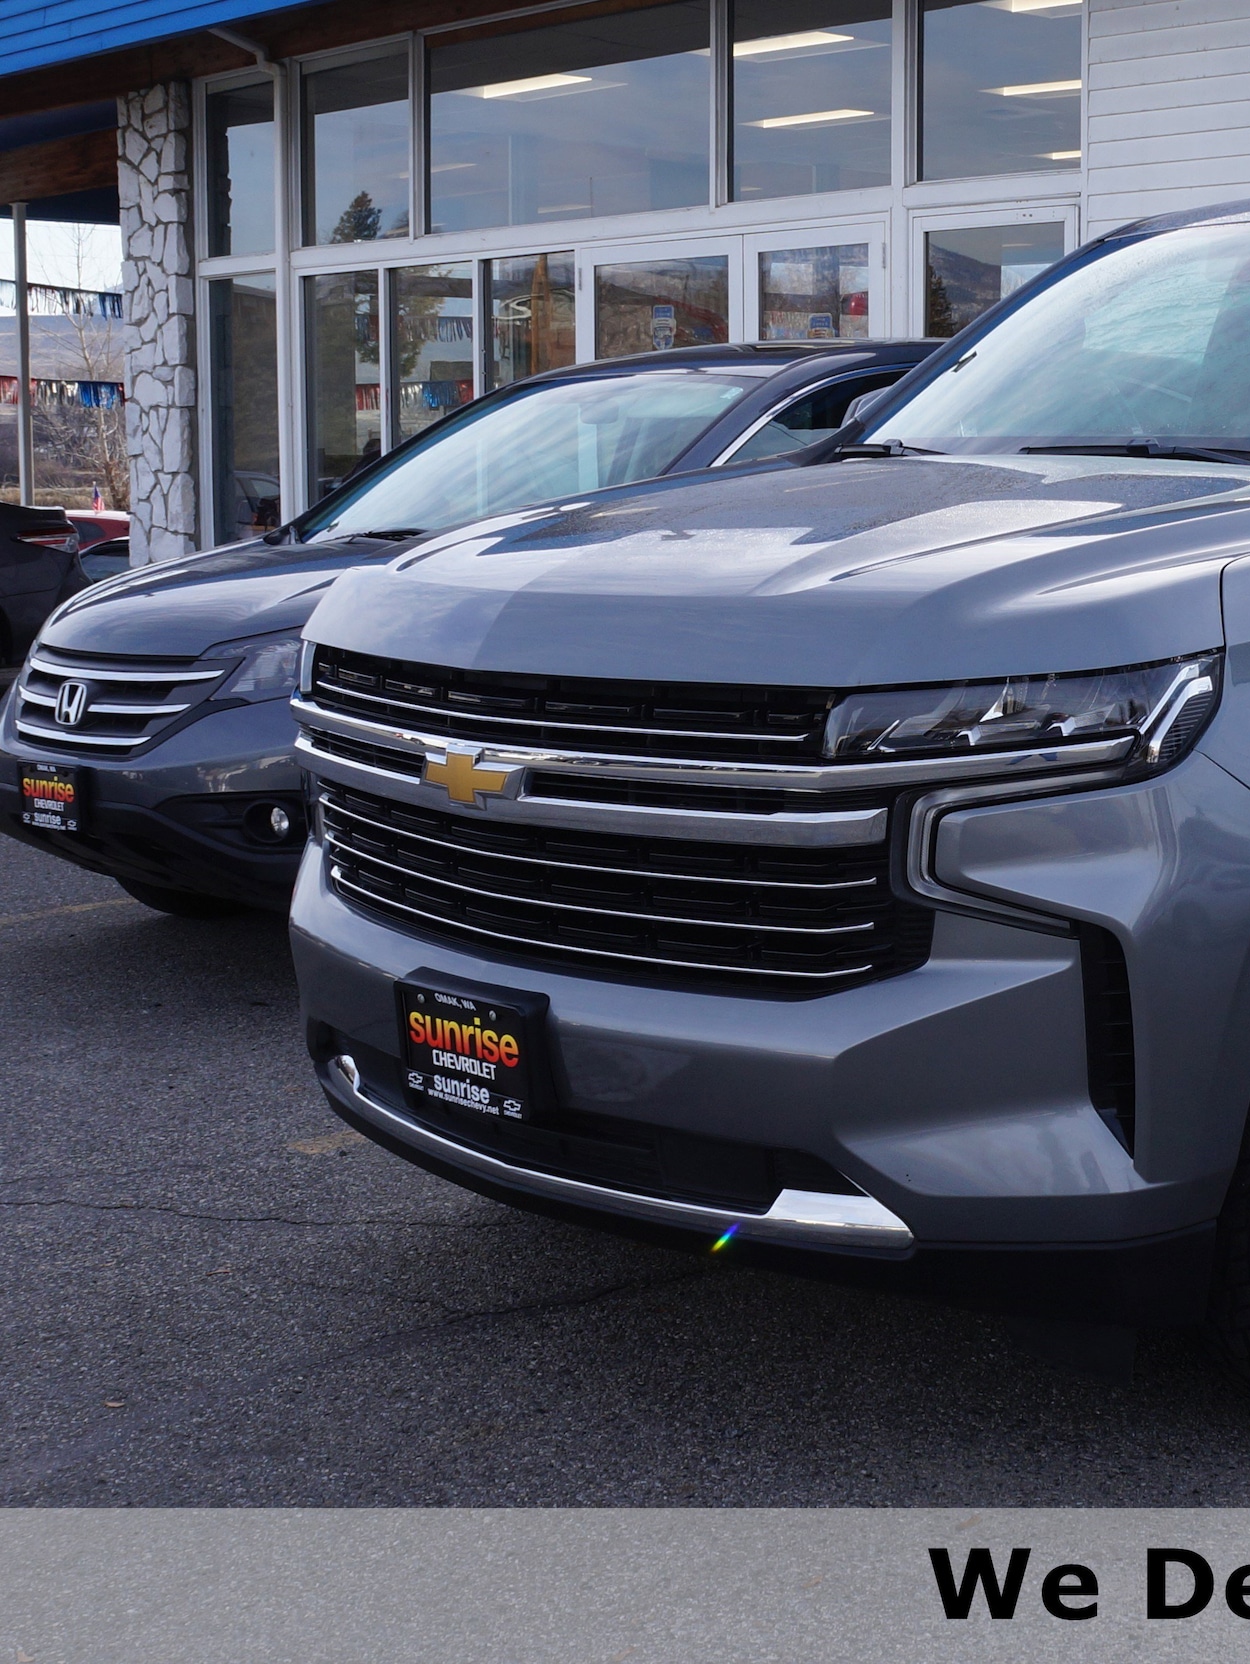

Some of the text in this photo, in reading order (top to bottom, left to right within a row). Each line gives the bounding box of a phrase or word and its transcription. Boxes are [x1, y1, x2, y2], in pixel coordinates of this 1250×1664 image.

[22, 776, 76, 803] sunrise
[34, 798, 65, 812] CHEVROLET
[460, 998, 477, 1011] WA
[409, 1011, 520, 1068] sunrise
[432, 1049, 497, 1081] CHEVROLET
[433, 1074, 490, 1104] sunrise
